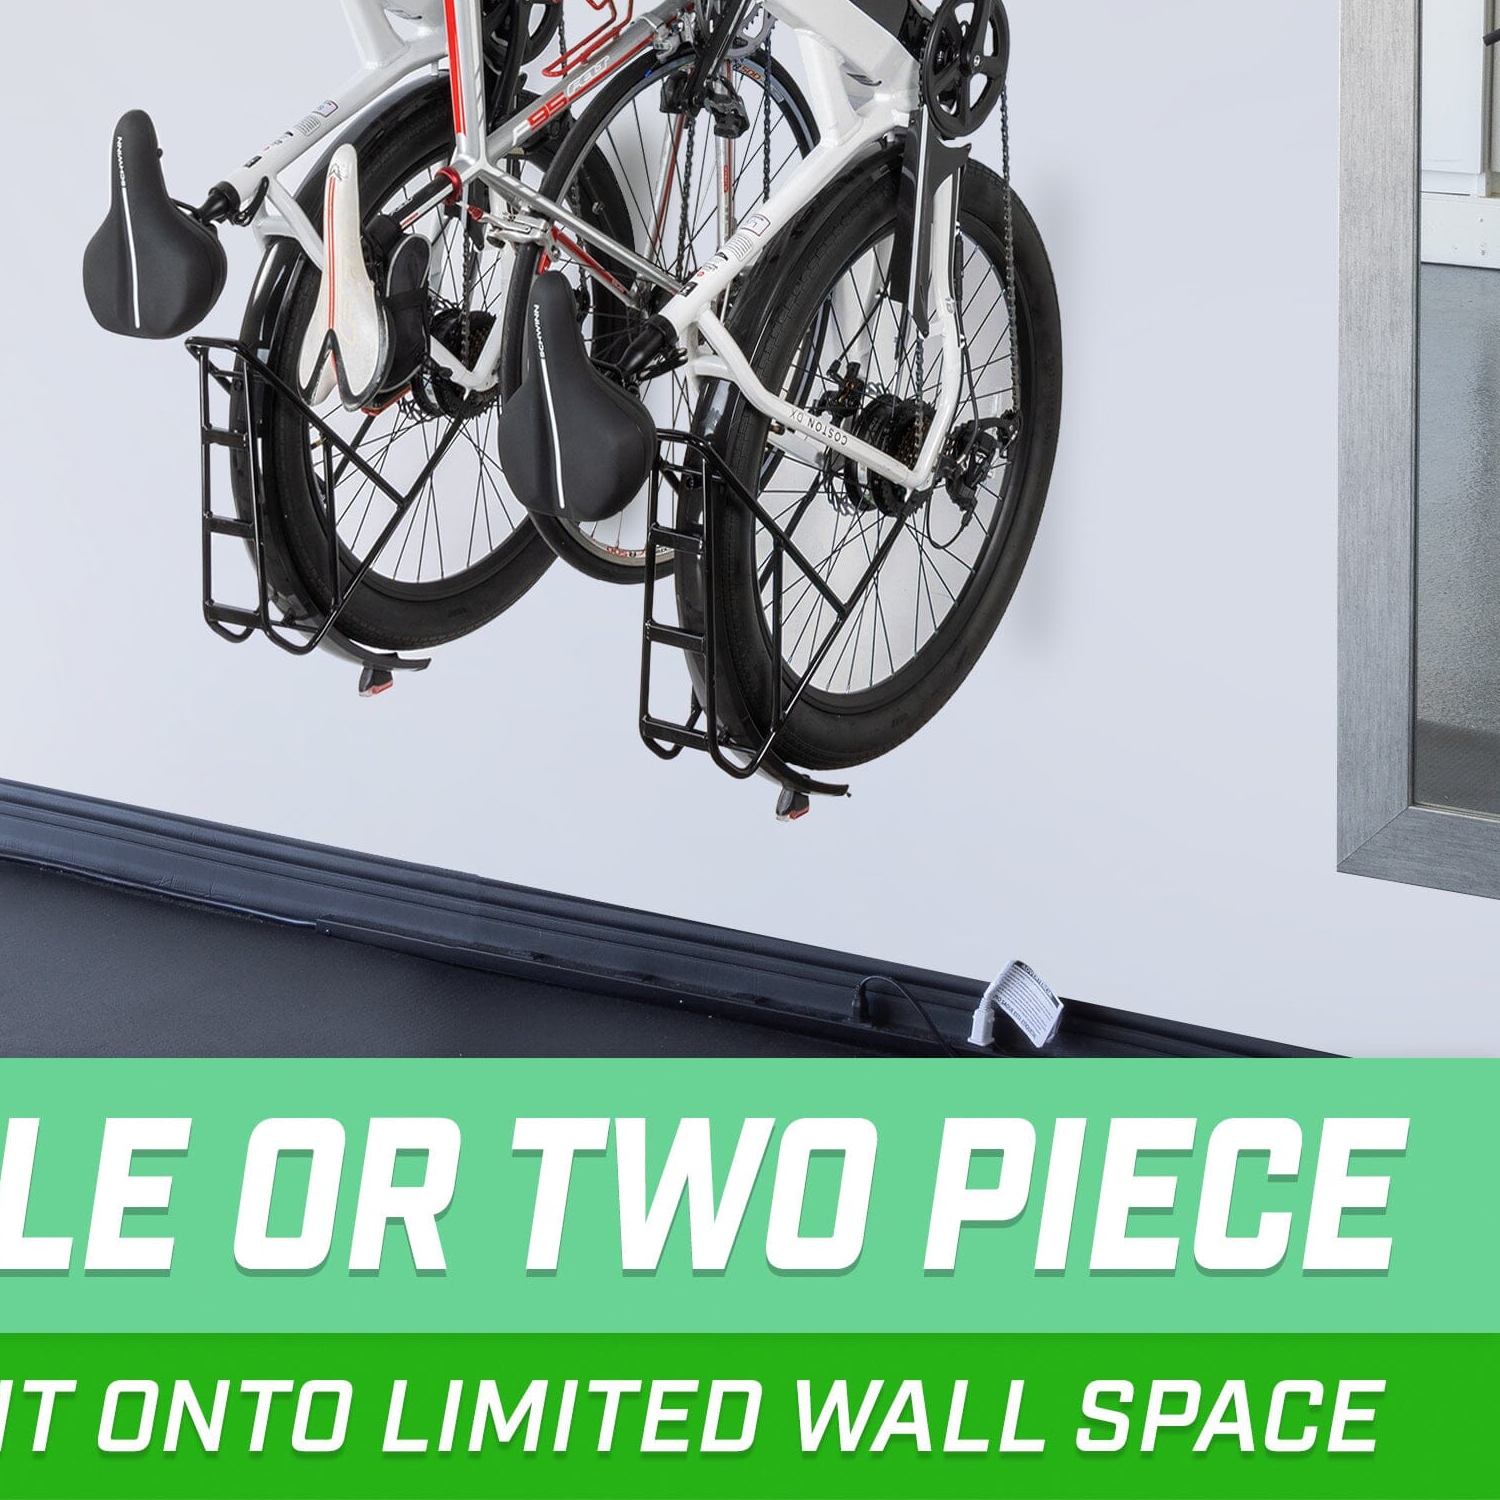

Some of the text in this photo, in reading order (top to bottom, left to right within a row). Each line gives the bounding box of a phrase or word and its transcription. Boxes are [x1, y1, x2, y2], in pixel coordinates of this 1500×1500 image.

[116, 136, 126, 187] SCHWINN
[533, 303, 546, 358] SCHWINN
[790, 408, 848, 446] COSTON DX
